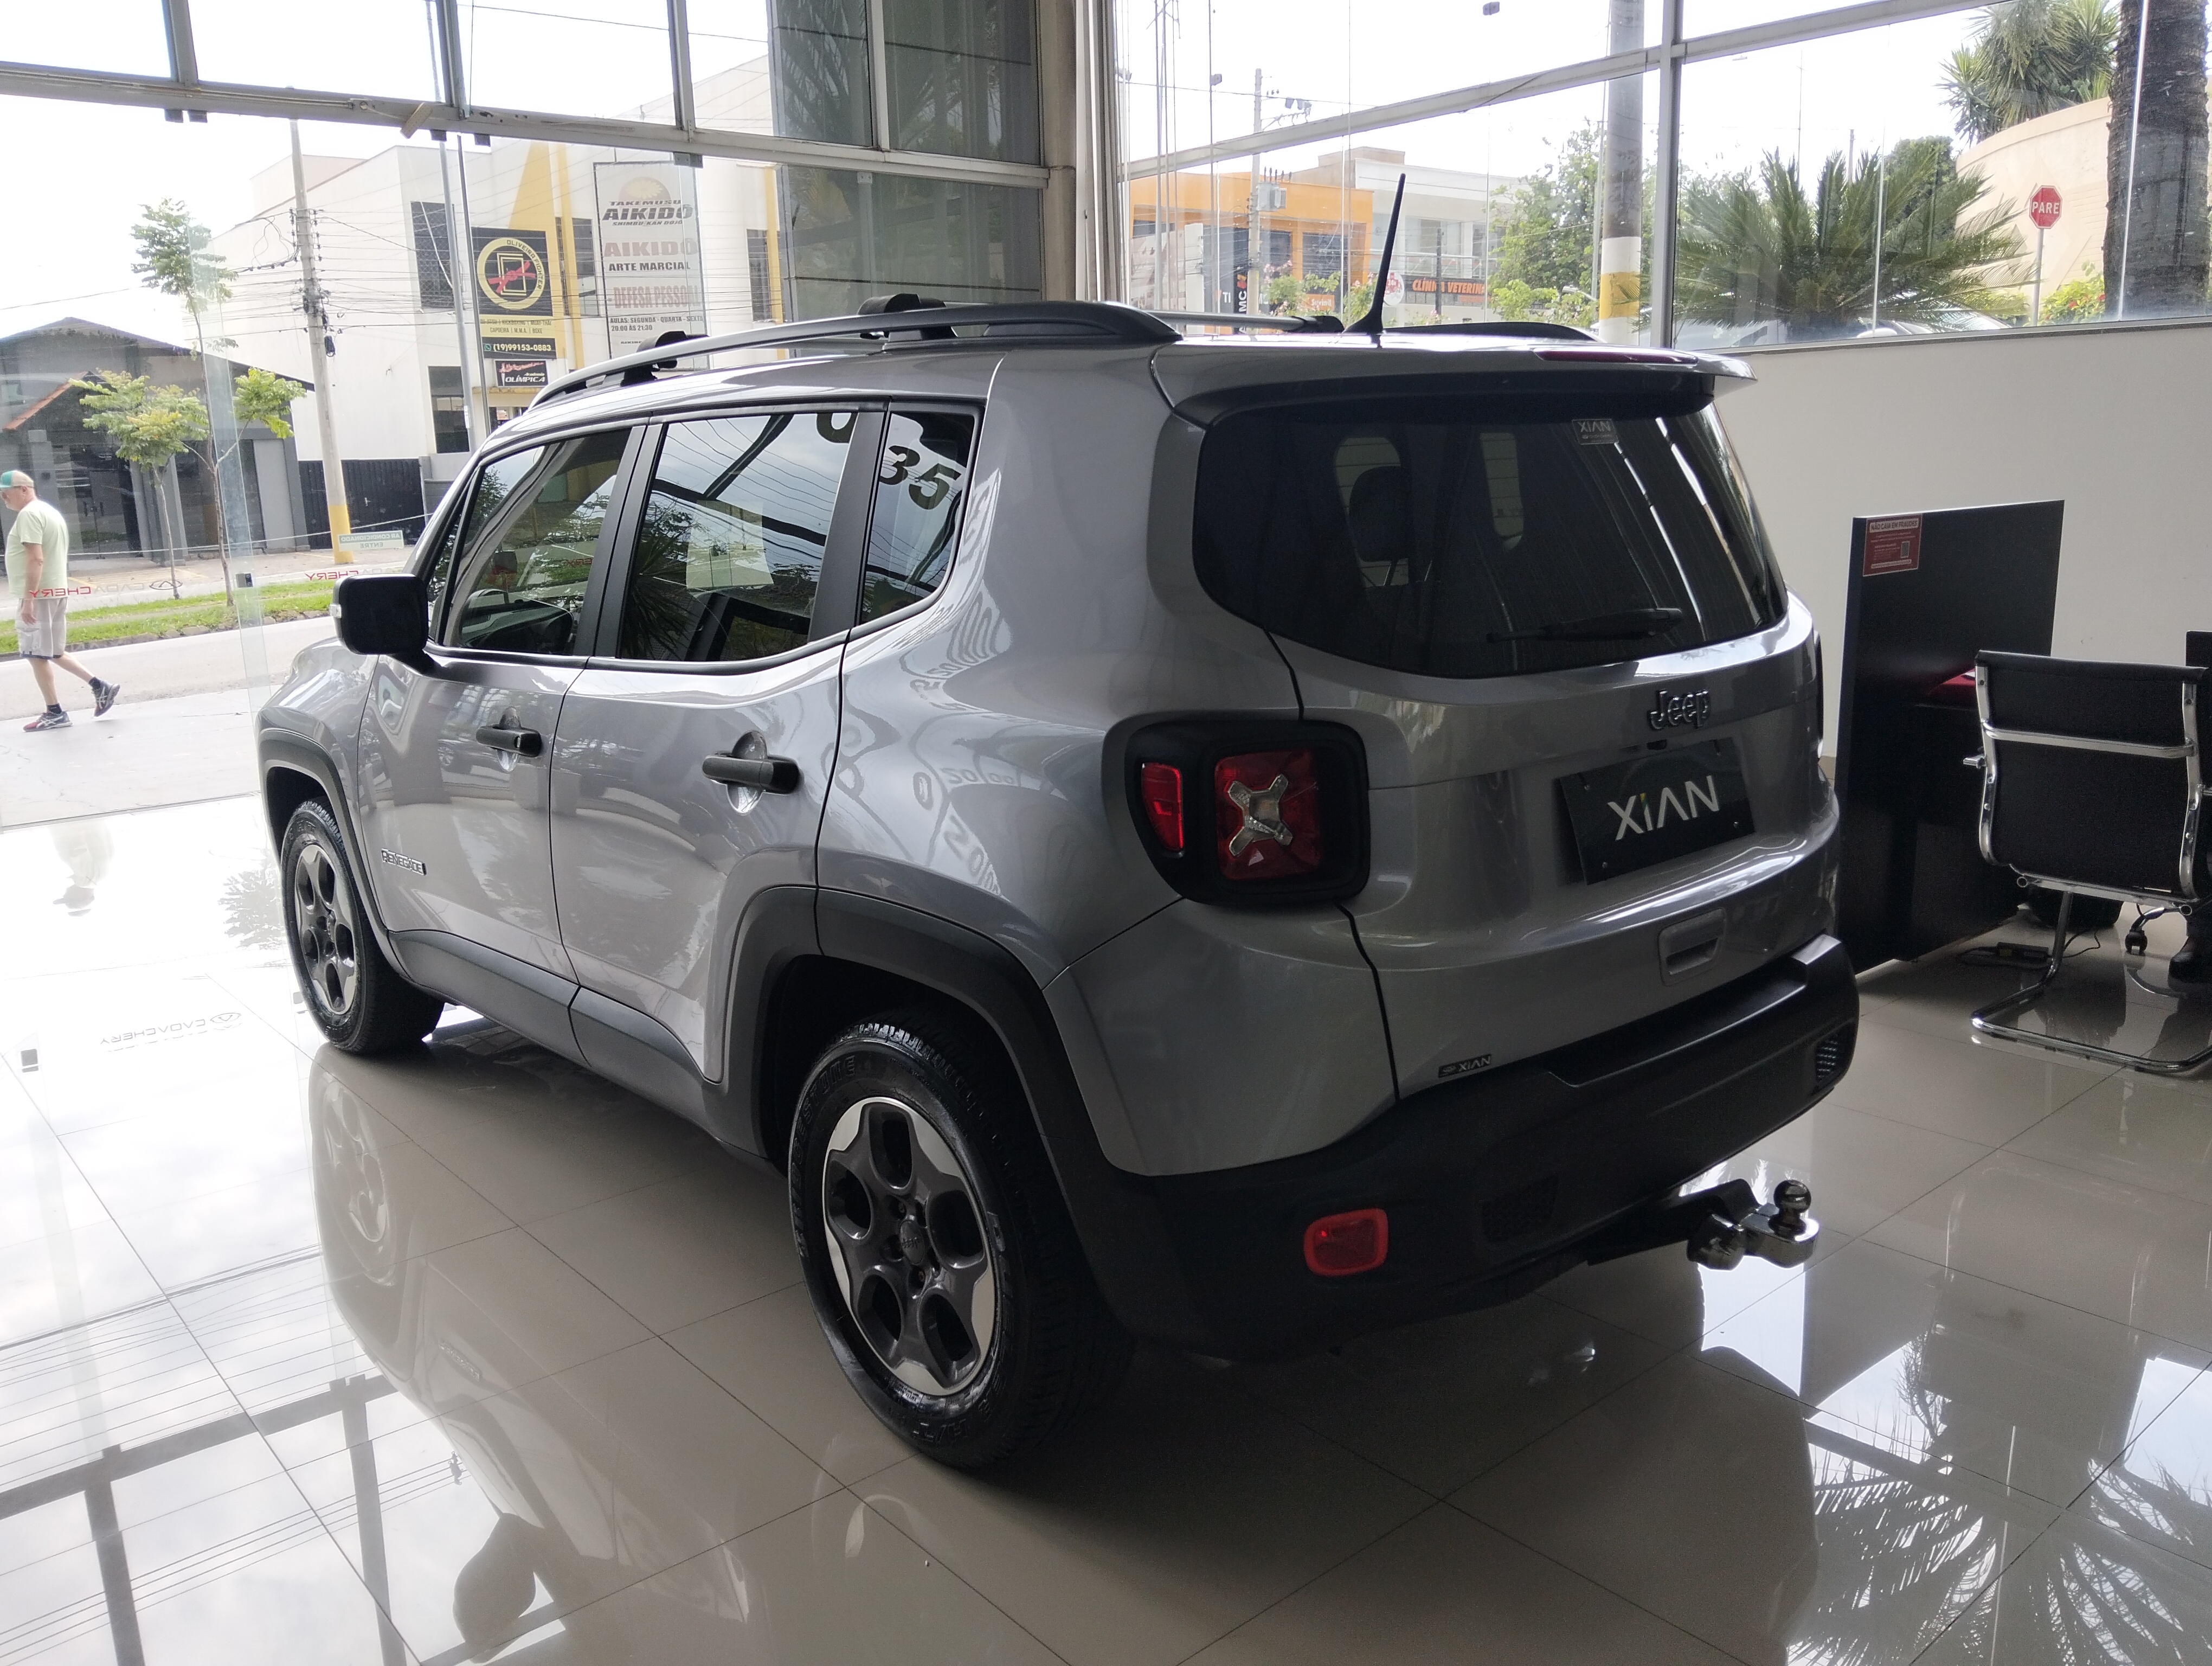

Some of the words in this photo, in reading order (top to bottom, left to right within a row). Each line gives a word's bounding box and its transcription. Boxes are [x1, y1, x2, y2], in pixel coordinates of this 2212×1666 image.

[2032, 201, 2060, 214] PARE
[506, 240, 536, 259] OLIVEIRA
[534, 259, 543, 290] FIGHTER
[609, 263, 636, 271] ARTE
[640, 262, 691, 270] MARCIAL
[613, 286, 653, 309] DEFESA
[653, 285, 701, 308] PESSOAL
[505, 375, 545, 383] OLÍMPICA
[1578, 421, 1611, 433] XIAN
[1647, 689, 1710, 731] Jeep
[1607, 775, 1720, 841] XIAN
[381, 850, 424, 875] RENEGADE
[1458, 1055, 1491, 1072] XIAN
